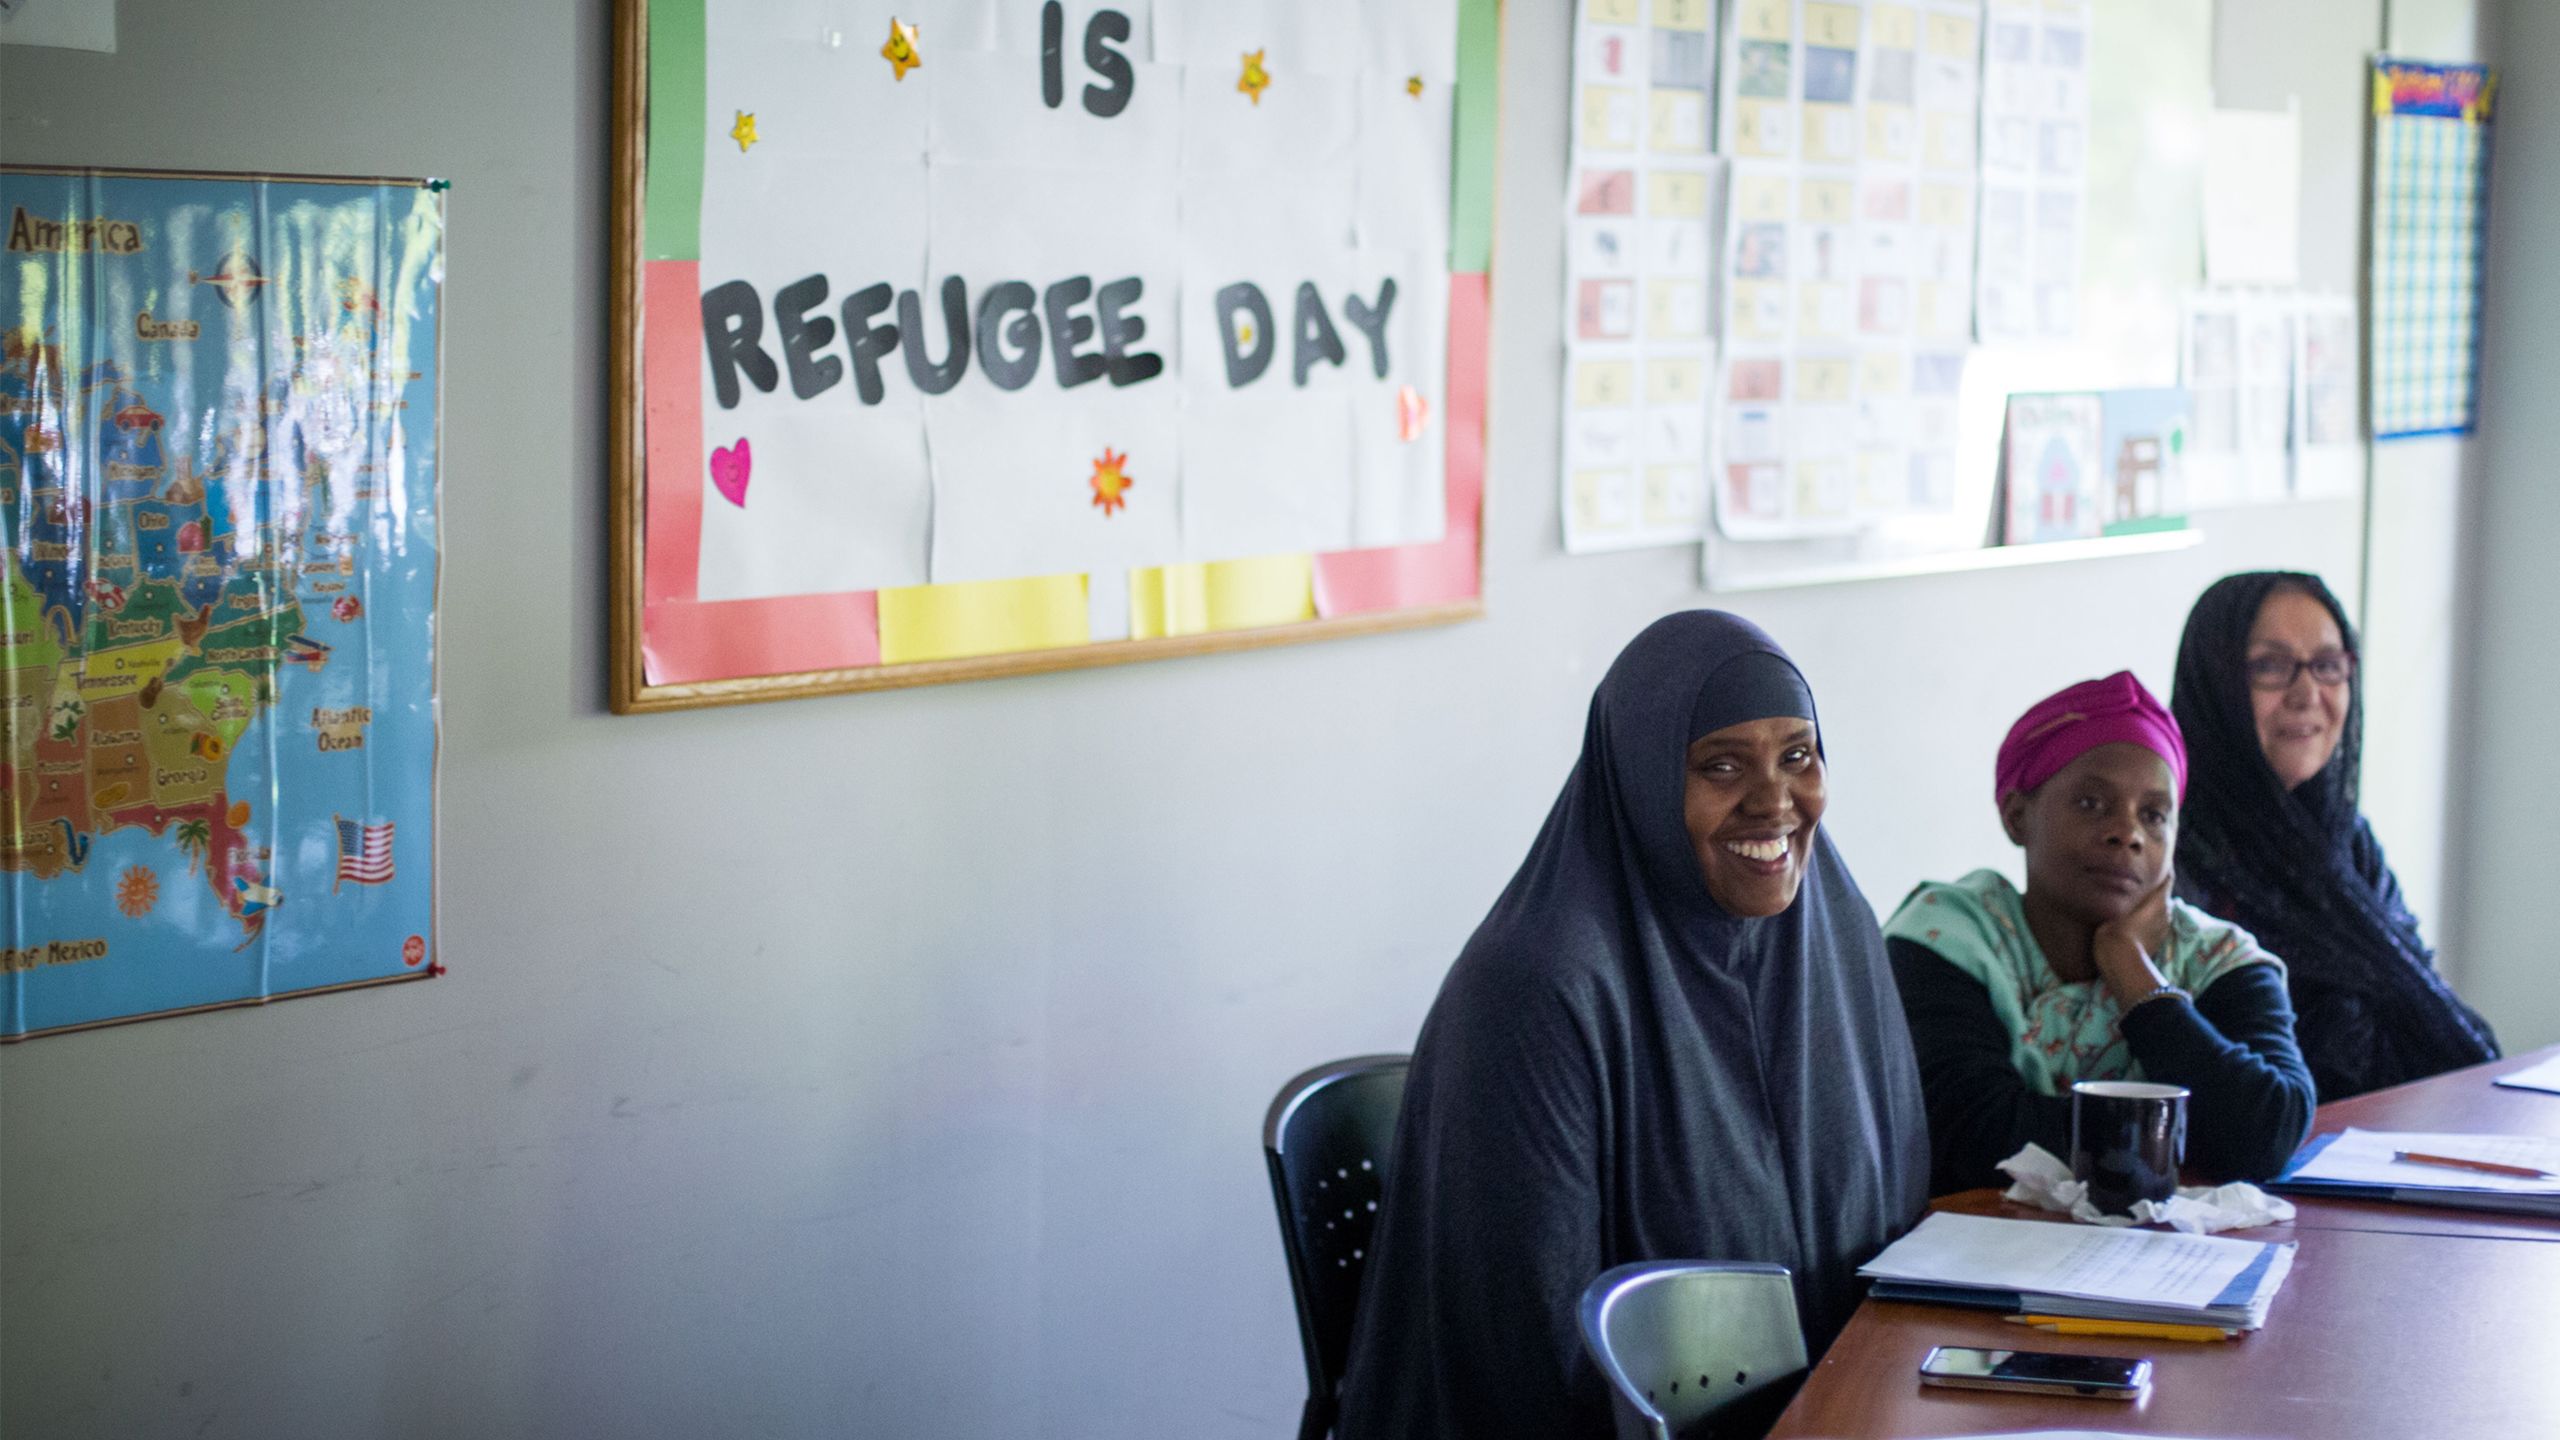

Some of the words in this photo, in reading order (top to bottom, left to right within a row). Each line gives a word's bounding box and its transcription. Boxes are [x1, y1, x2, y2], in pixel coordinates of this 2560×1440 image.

[1041, 0, 1135, 118] IS
[8, 206, 141, 252] America
[700, 273, 1164, 410] REFUGEE
[1216, 276, 1398, 389] DAY
[70, 672, 137, 690] Tennessee
[318, 731, 363, 751] Ocean
[156, 767, 208, 786] Georgia
[48, 940, 107, 964] Mexico
